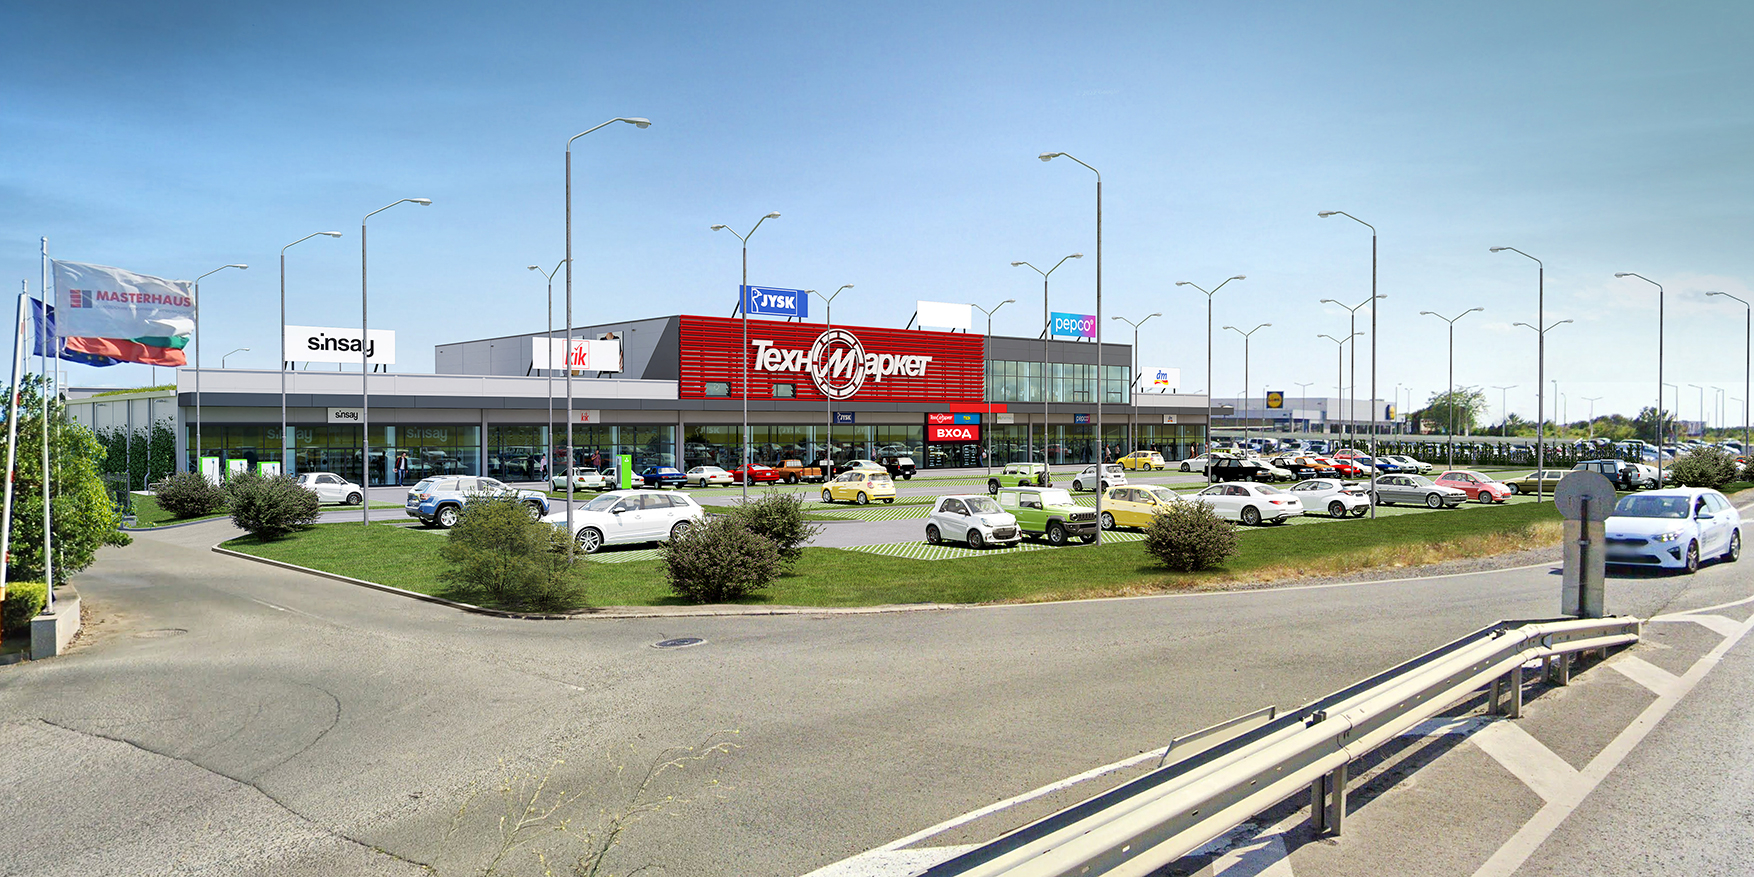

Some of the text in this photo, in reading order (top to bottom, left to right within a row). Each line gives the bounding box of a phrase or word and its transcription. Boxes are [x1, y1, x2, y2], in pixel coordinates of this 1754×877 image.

[96, 290, 191, 308] MASTERHAUS
[760, 294, 796, 310] JYSK
[307, 333, 374, 358] sinsay
[1156, 370, 1168, 380] dm
[335, 410, 358, 421] sinsay
[936, 428, 972, 439] ВХОД
